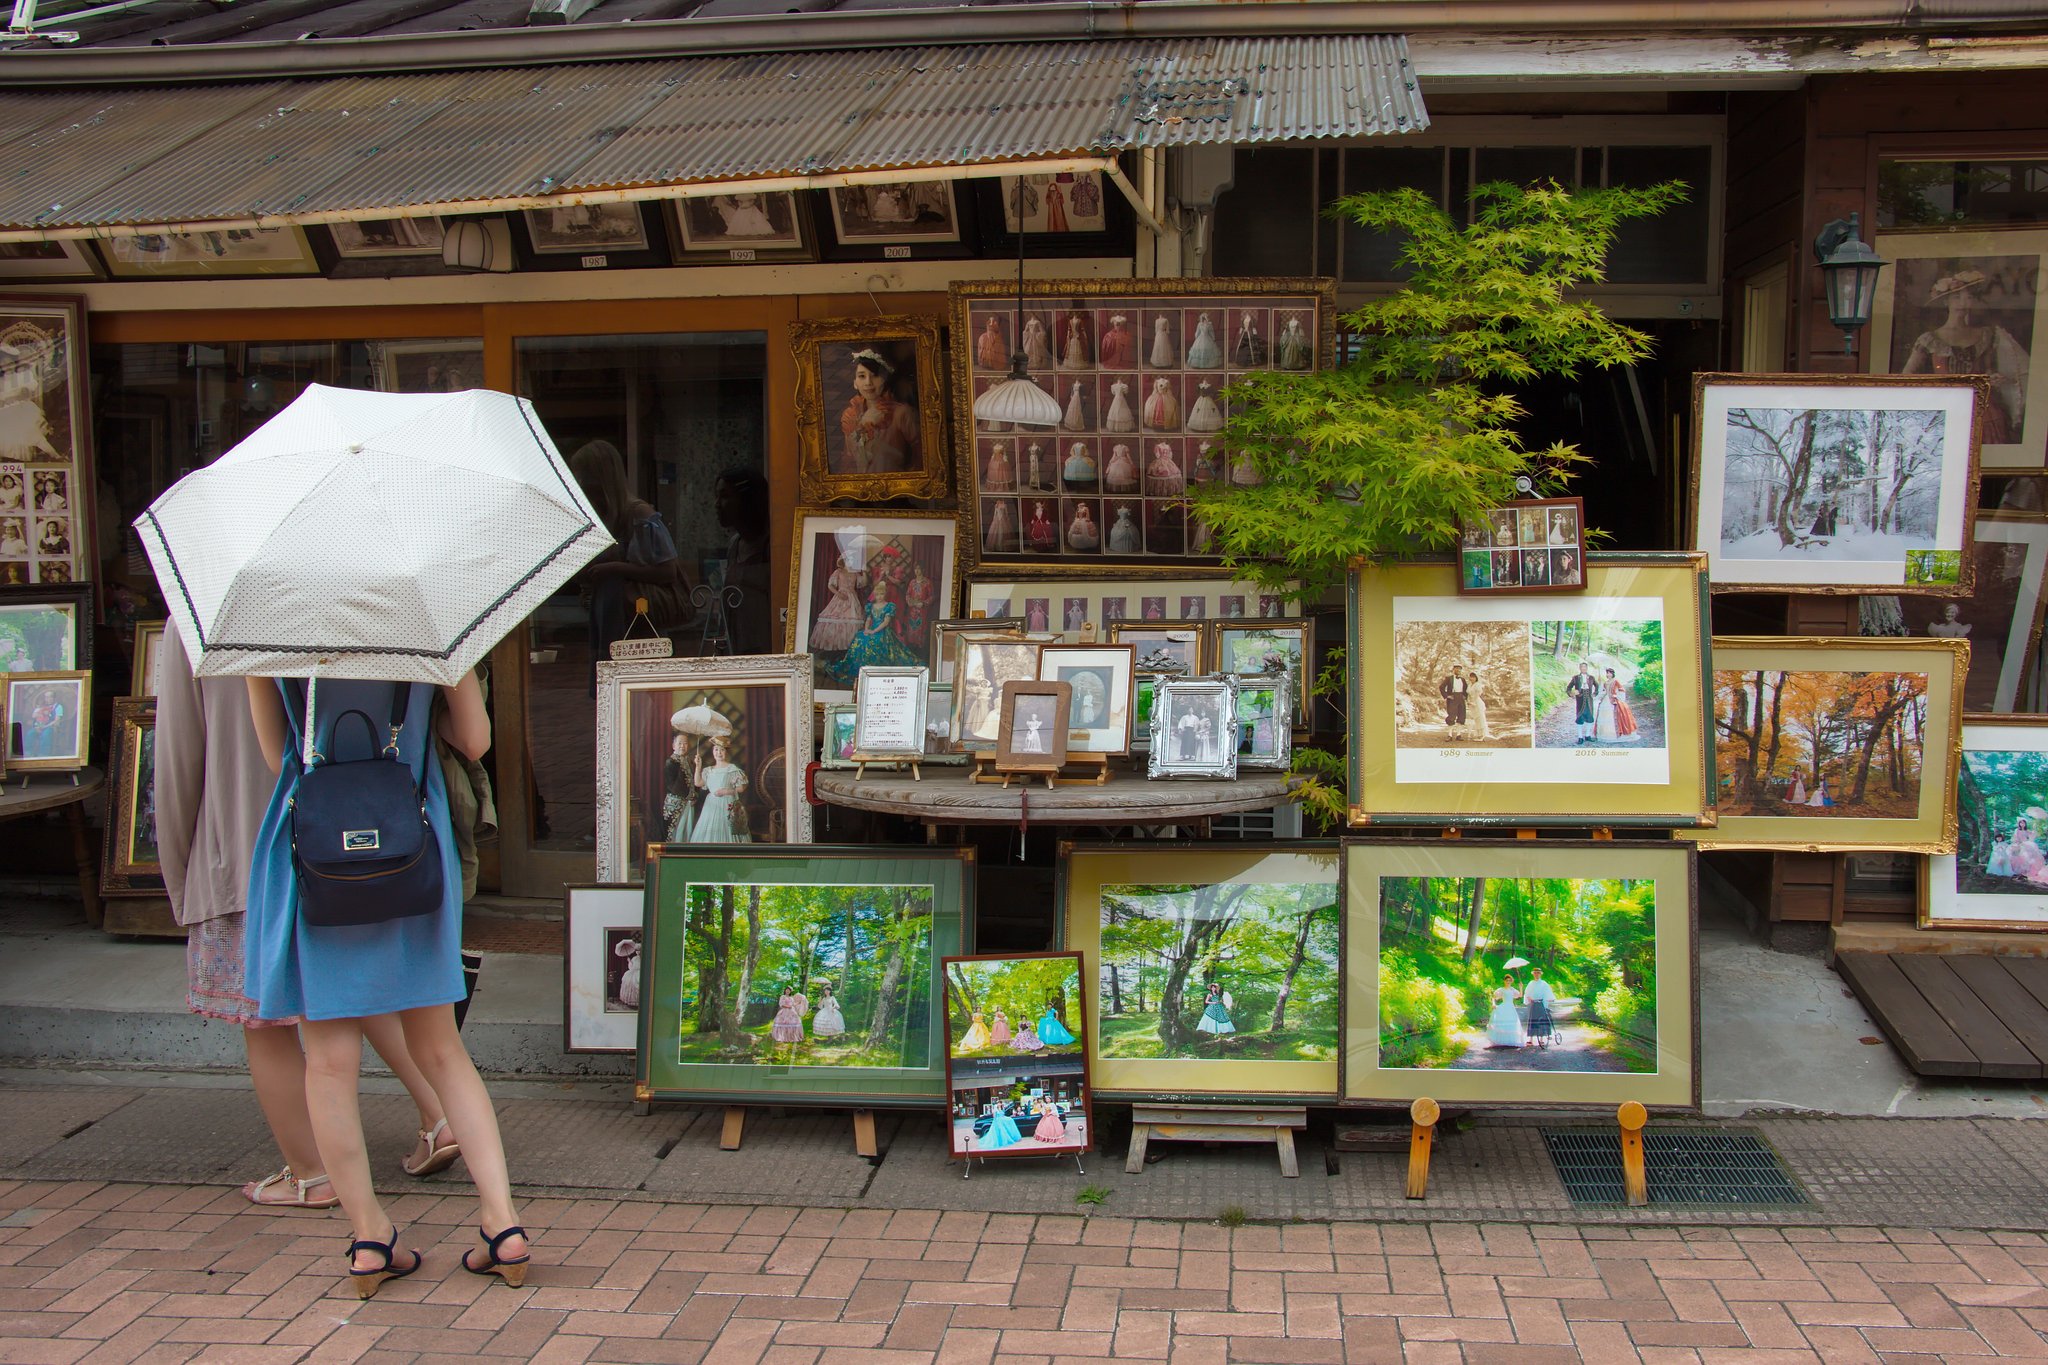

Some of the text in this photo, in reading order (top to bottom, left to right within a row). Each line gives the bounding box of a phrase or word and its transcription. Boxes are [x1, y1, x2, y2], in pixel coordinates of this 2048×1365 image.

[731, 251, 754, 260] 1997
[886, 247, 909, 257] 2007
[583, 257, 605, 267] 1987
[1440, 748, 1461, 758] 1989
[1575, 748, 1630, 757] 2016 Summer
